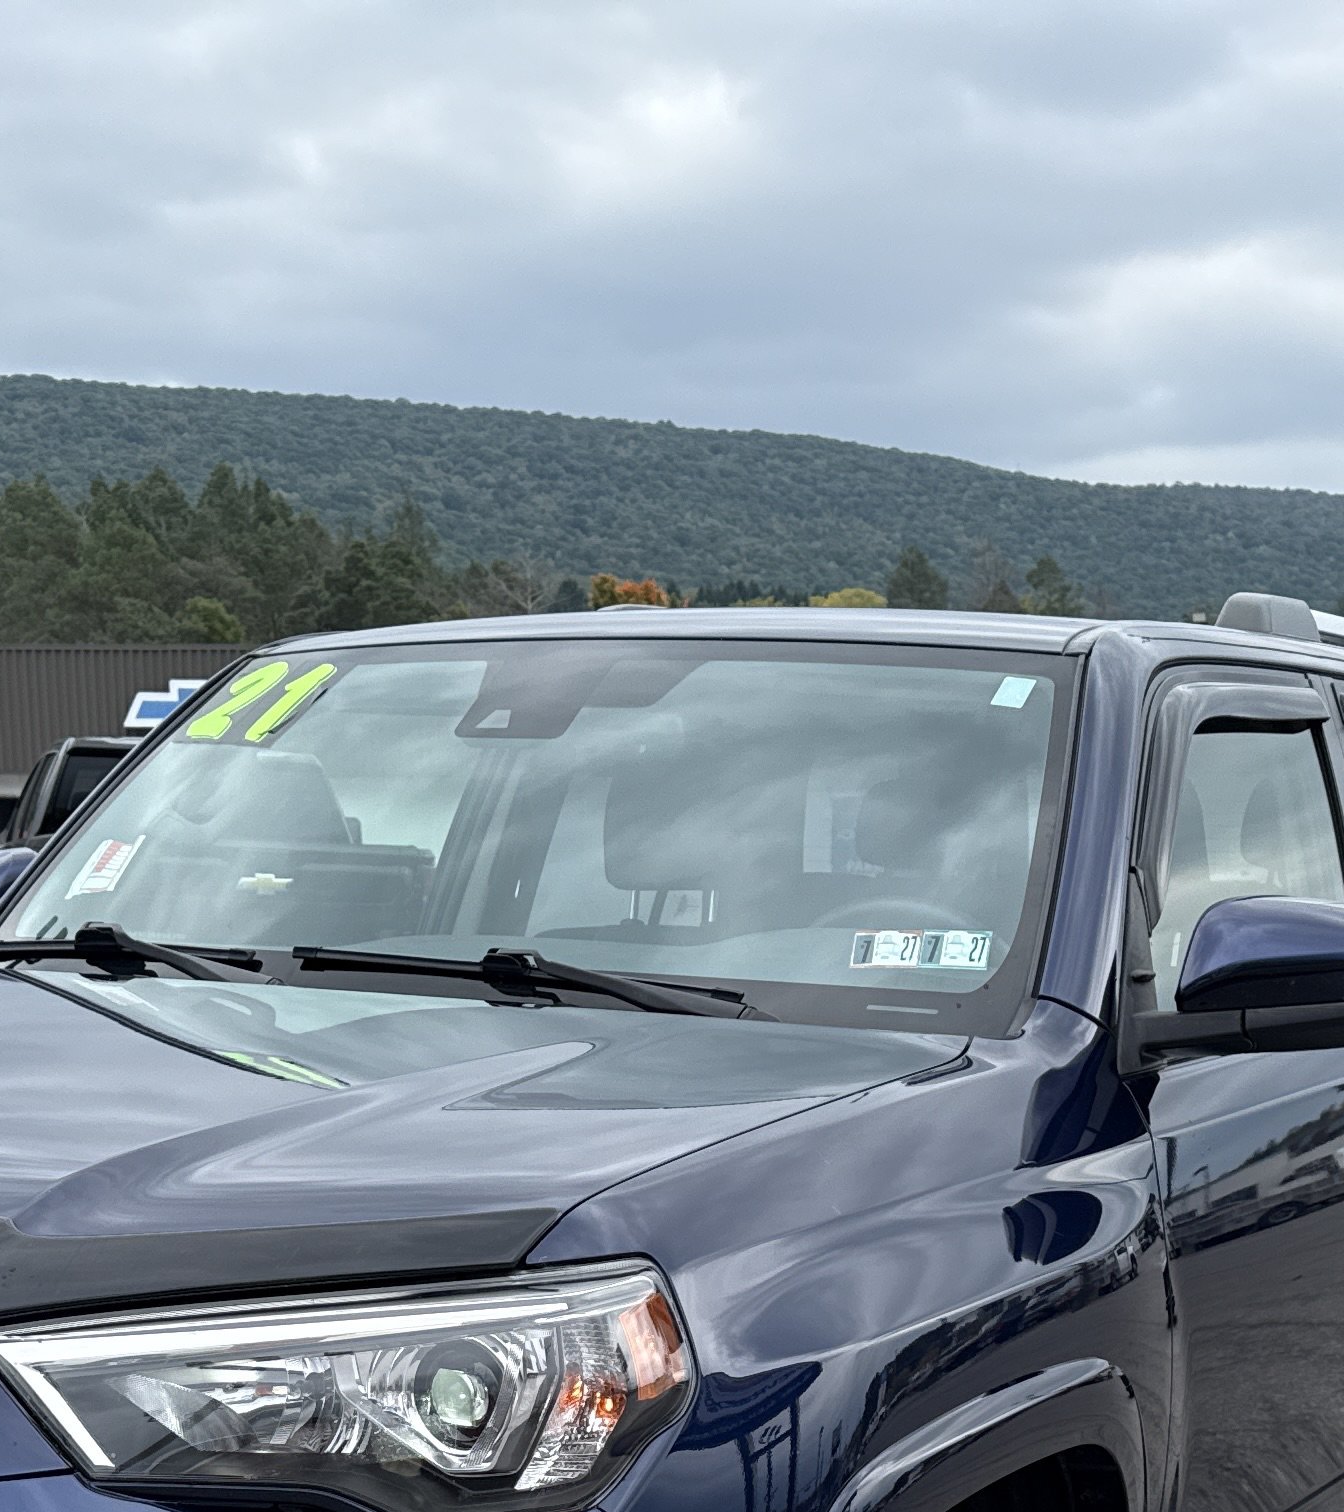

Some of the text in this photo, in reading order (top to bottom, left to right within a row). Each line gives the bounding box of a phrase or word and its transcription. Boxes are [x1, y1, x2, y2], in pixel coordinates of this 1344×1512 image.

[186, 661, 338, 743] 21
[899, 935, 918, 962] 27
[927, 935, 987, 963] 7 27
